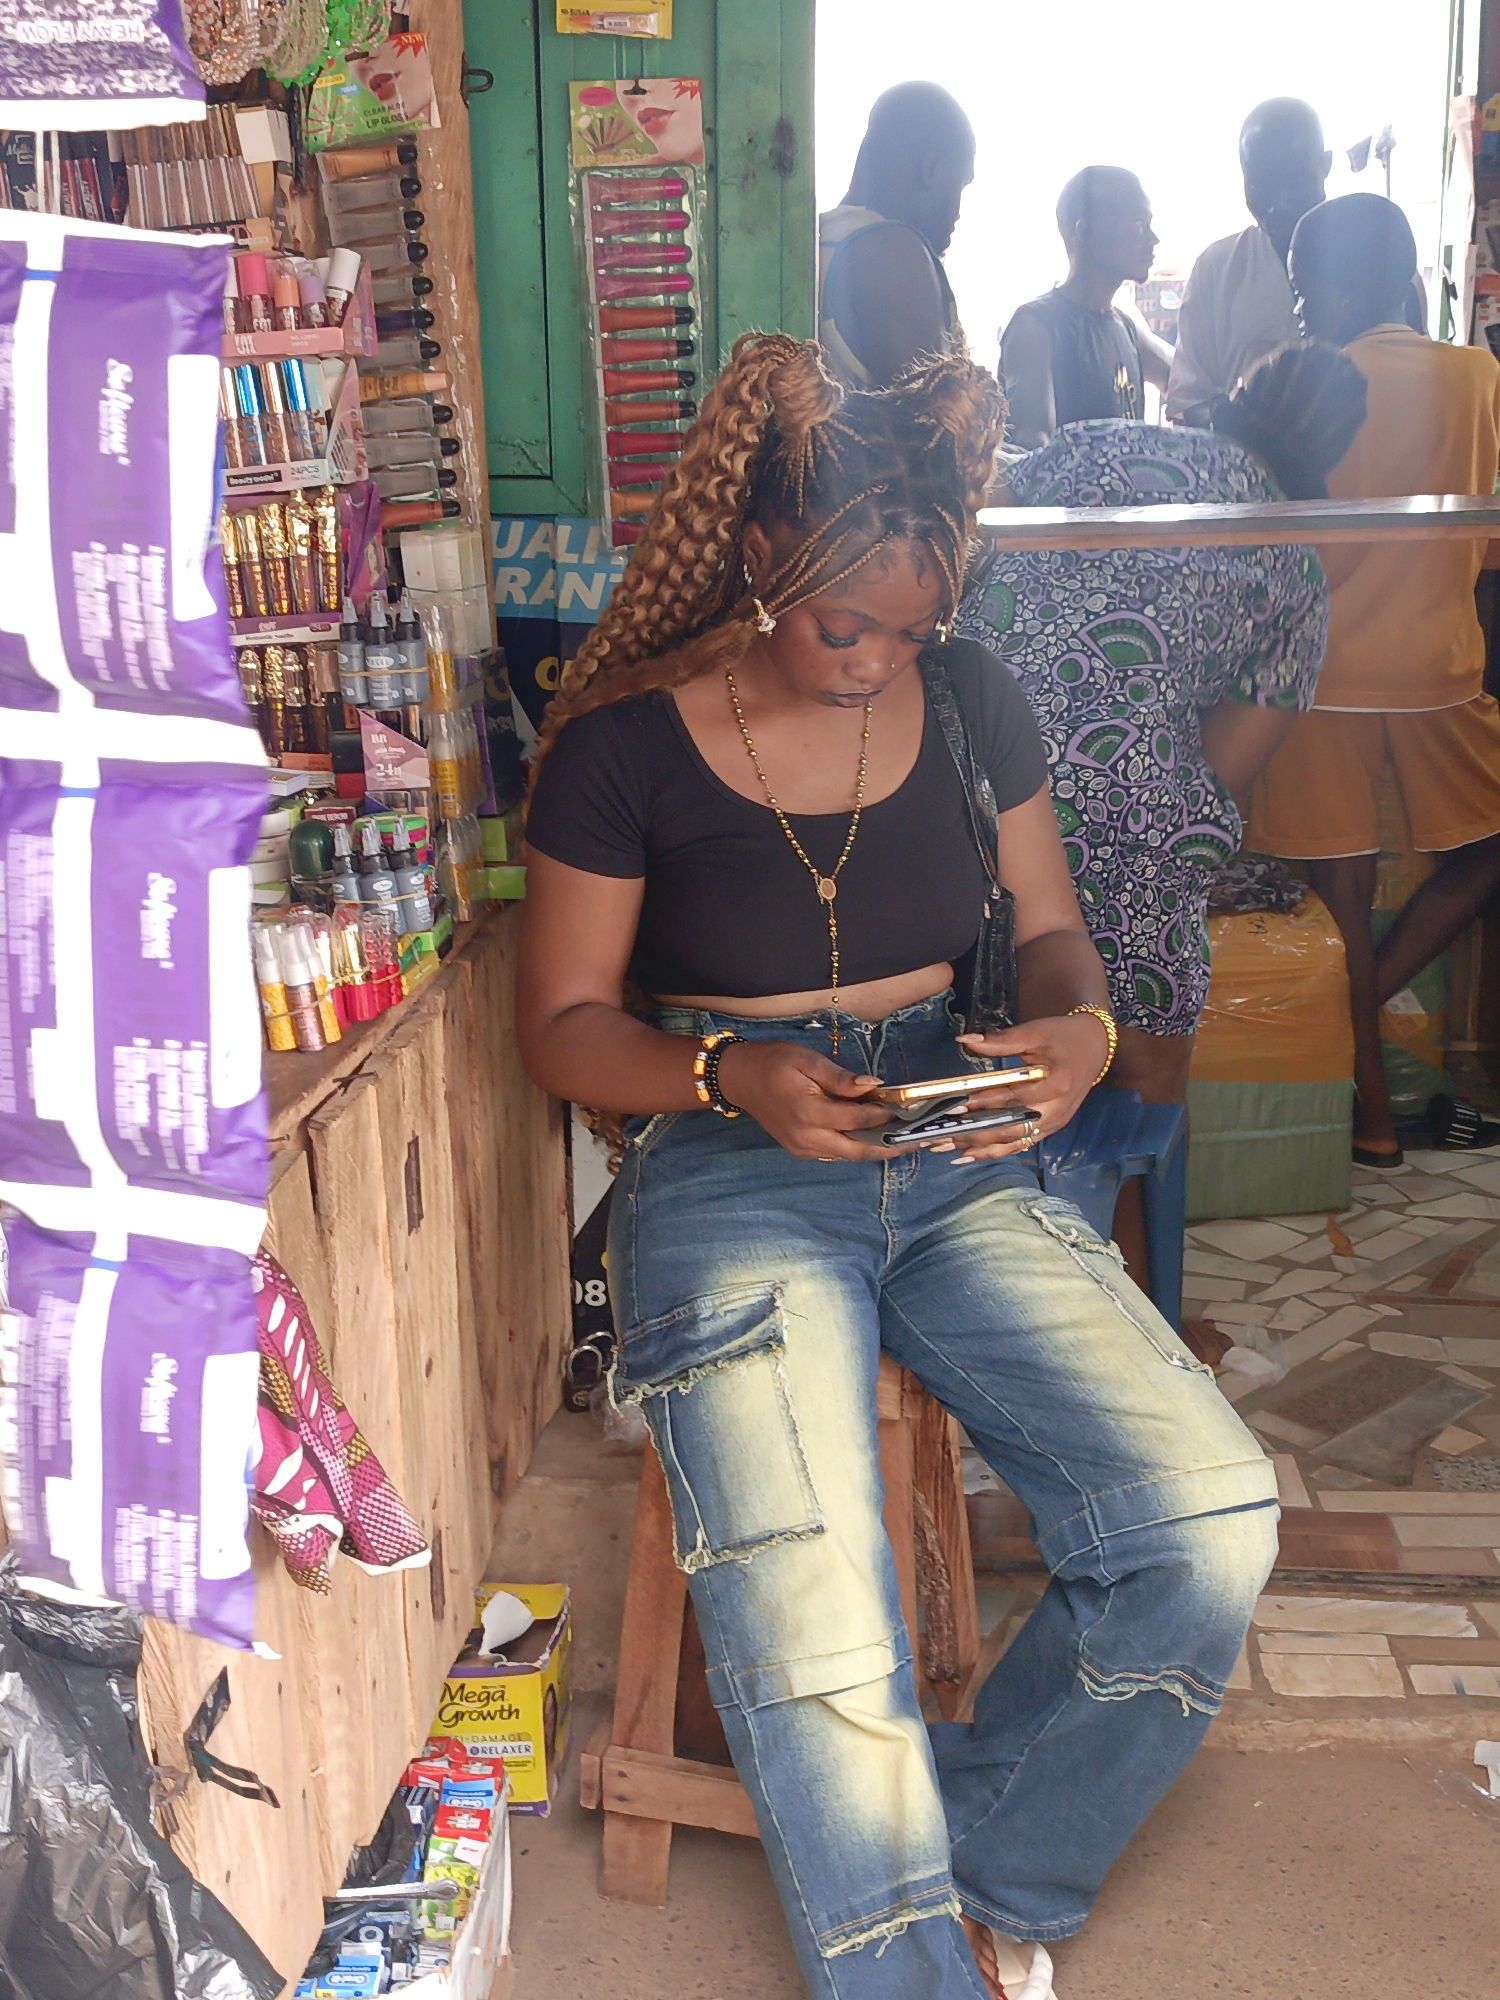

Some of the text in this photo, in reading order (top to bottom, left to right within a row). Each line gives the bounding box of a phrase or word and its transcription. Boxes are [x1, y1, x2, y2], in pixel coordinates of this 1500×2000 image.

[20, 23, 143, 41] HEAVY FLOW
[681, 80, 700, 88] NEW
[440, 1682, 506, 1709] Mega
[438, 1703, 520, 1728] Growth
[480, 1744, 531, 1755] RELAXER
